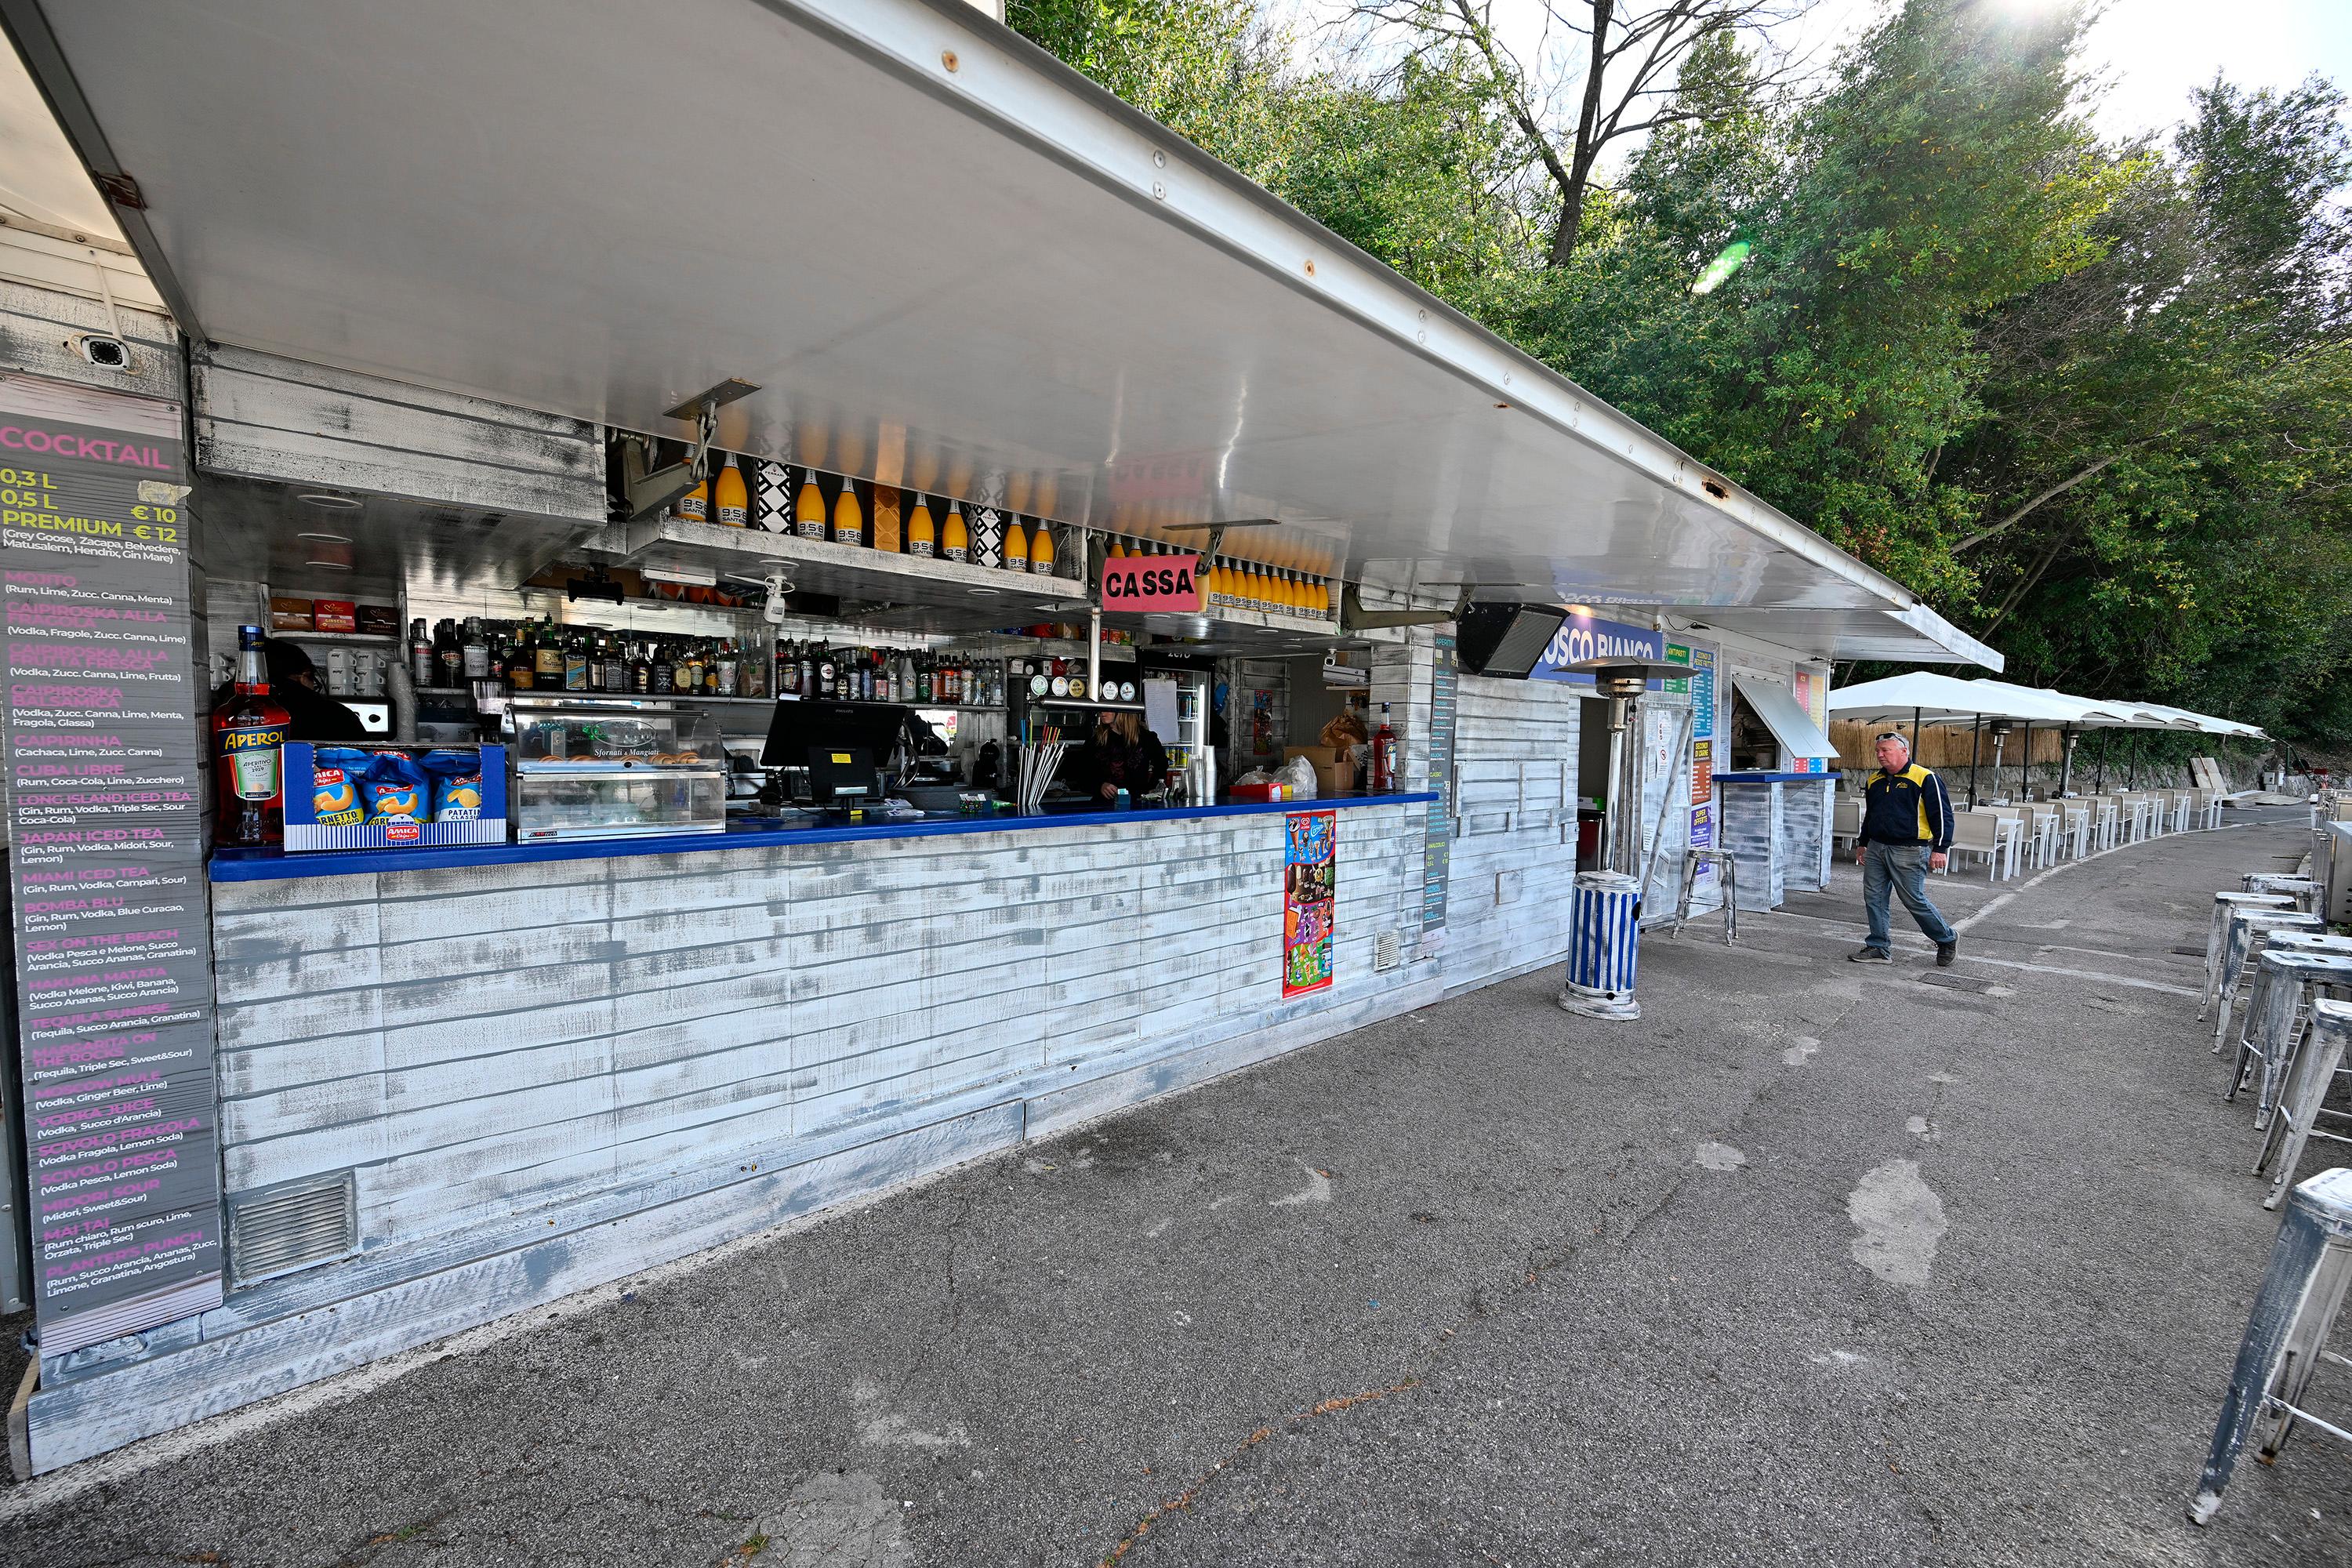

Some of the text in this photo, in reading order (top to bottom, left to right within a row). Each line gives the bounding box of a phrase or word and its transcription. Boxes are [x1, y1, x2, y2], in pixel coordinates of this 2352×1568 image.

[0, 426, 172, 470] COCKTAIL
[0, 468, 57, 489] 0,3 L
[1, 488, 58, 510] 0,5 L
[2, 510, 122, 537] PREMIUM
[2, 528, 181, 555] (Grey Goose, Zacapa, Belvedere,
[2, 539, 173, 564] Matusalem, Hendrix, Gin Mare)
[5, 572, 76, 587] MOJITO
[1106, 568, 1194, 597] CASSA
[5, 585, 172, 605] (Rum, Lime, Zucc. Canna, Menta)
[5, 602, 167, 622] CAIPIROSKA ALLA
[7, 612, 97, 628] FRAGOLA
[8, 626, 187, 644] (Vodka, Fragole, Zucc. Canna, Lime)
[14, 735, 122, 746] CAIPIRINHA
[225, 731, 285, 750] APEROL
[15, 748, 67, 757] (Cachaca,
[69, 749, 98, 757] Lime,
[128, 749, 162, 757] Canna)
[243, 759, 271, 768] APERITIVO
[594, 749, 622, 757] Sfornati
[629, 749, 659, 757] Mangiati
[16, 764, 125, 776] CUBA LIBRE
[16, 776, 184, 788] (Rum, Coca-Cola, Lime, Zucchero)
[18, 792, 192, 806] LONG ISLAND ICED TEA
[19, 807, 43, 816] (Gin,
[45, 806, 74, 815] Rum,
[74, 804, 111, 813] Vodka,
[112, 804, 140, 813] Triple
[19, 815, 76, 825] Coca-Cola)
[27, 929, 179, 953] SEX ON THE BEACH
[27, 953, 64, 964] (Vodka
[67, 949, 97, 958] Pesca
[108, 944, 147, 953] Melone,
[27, 947, 196, 972] Arancia, Succo Ananas, Granatina)
[30, 1004, 171, 1029] TEQUILA SUNRISE
[31, 1010, 201, 1041] (Tequila, Succo Arancia, Granatina)
[34, 1070, 162, 1099] MOSCOW MULE
[35, 1081, 167, 1111] (Vodka, Ginger Beer, Lime)
[36, 1098, 155, 1128] VODKA JUICE
[38, 1126, 77, 1139] (Vodka,
[81, 1120, 112, 1131] Succo
[38, 1117, 200, 1156] SCIVOLO FRAGOLA
[39, 1132, 183, 1168] (Vodka Fragola, Lemon Soda)
[42, 1178, 160, 1213] MIDORI SOUR
[42, 1193, 147, 1225] (Midori, Sweet&Sour)
[43, 1217, 110, 1242] MAI TAI
[44, 1210, 192, 1253] (Rum chiaro, Rum scuro, Lime,
[44, 1233, 134, 1261] Orzata, Triple Sec)
